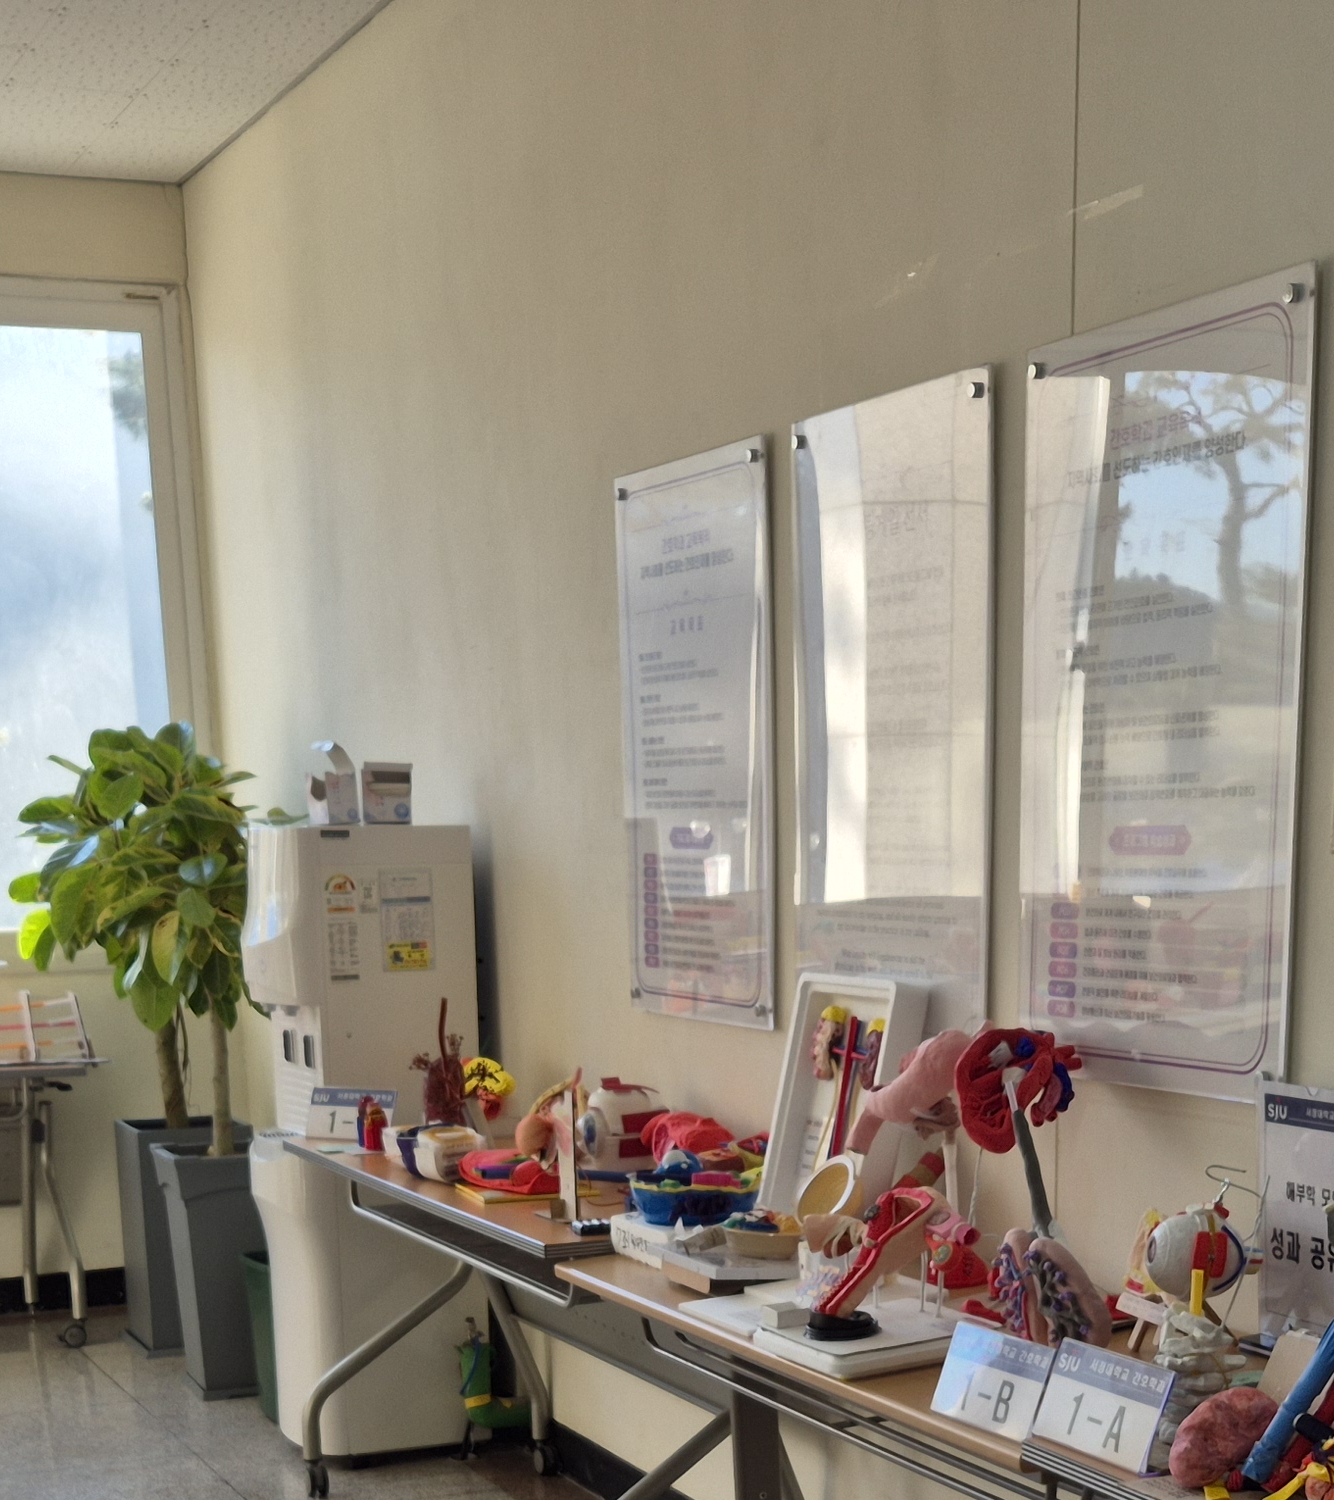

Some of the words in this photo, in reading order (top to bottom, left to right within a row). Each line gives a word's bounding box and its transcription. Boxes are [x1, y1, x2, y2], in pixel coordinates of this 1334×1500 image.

[1267, 1103, 1288, 1120] SJU
[1286, 1181, 1315, 1205] 해부학
[1270, 1227, 1301, 1264] 성과
[1058, 1353, 1080, 1373] SJU
[1089, 1358, 1129, 1380] 서정대학교
[1132, 1371, 1166, 1393] 간호학과
[1067, 1392, 1126, 1453] 1-A
